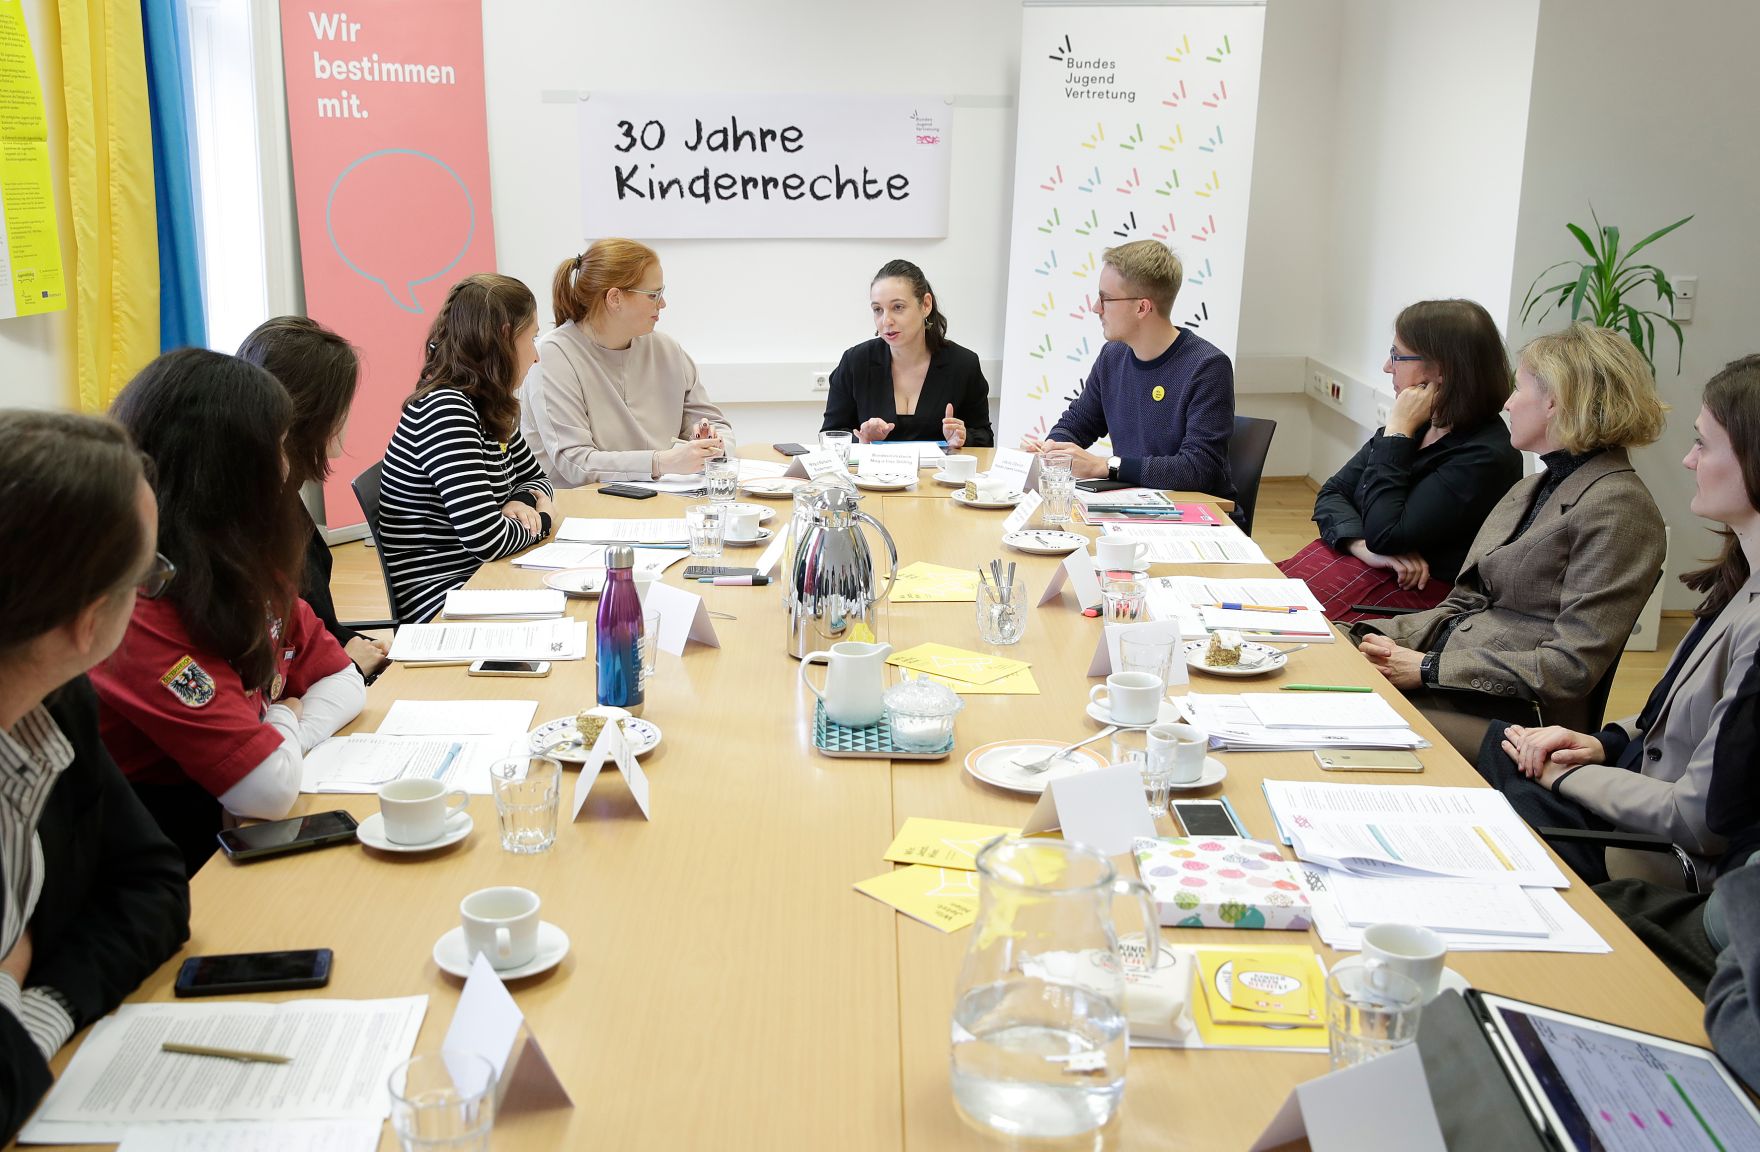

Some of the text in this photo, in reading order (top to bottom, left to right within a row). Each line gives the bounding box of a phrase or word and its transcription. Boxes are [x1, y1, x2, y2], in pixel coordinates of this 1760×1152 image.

[308, 11, 361, 42] Wir
[313, 51, 455, 85] bestimmen
[1066, 58, 1116, 70] Bundes
[1065, 73, 1115, 87] Jugend
[1065, 87, 1136, 103] Vertretung
[317, 89, 369, 119] mit.
[614, 116, 804, 153] 30 Jahre
[614, 163, 911, 204] Kinderrechte
